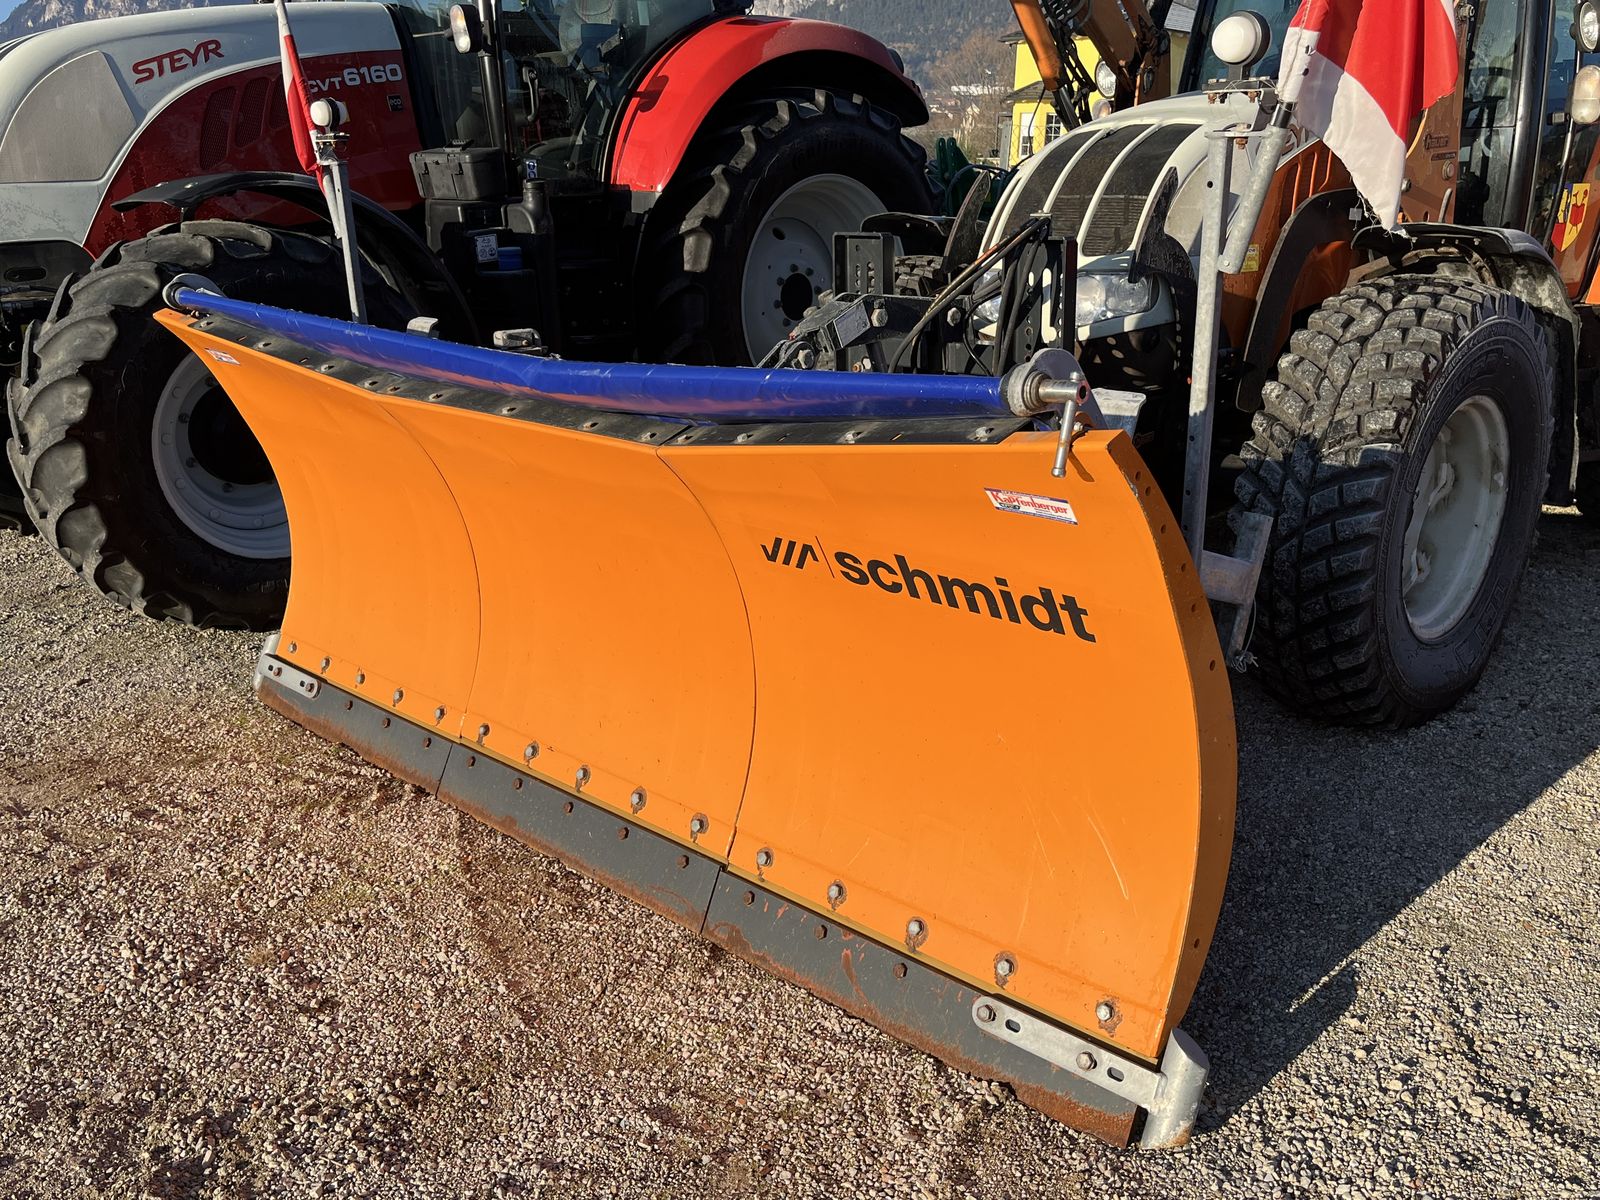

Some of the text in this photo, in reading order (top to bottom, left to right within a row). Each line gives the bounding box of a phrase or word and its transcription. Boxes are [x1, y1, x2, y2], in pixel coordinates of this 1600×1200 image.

[132, 39, 225, 85] STEYR
[990, 490, 1069, 515] Kapfenberger
[834, 550, 1097, 644] schmidt
